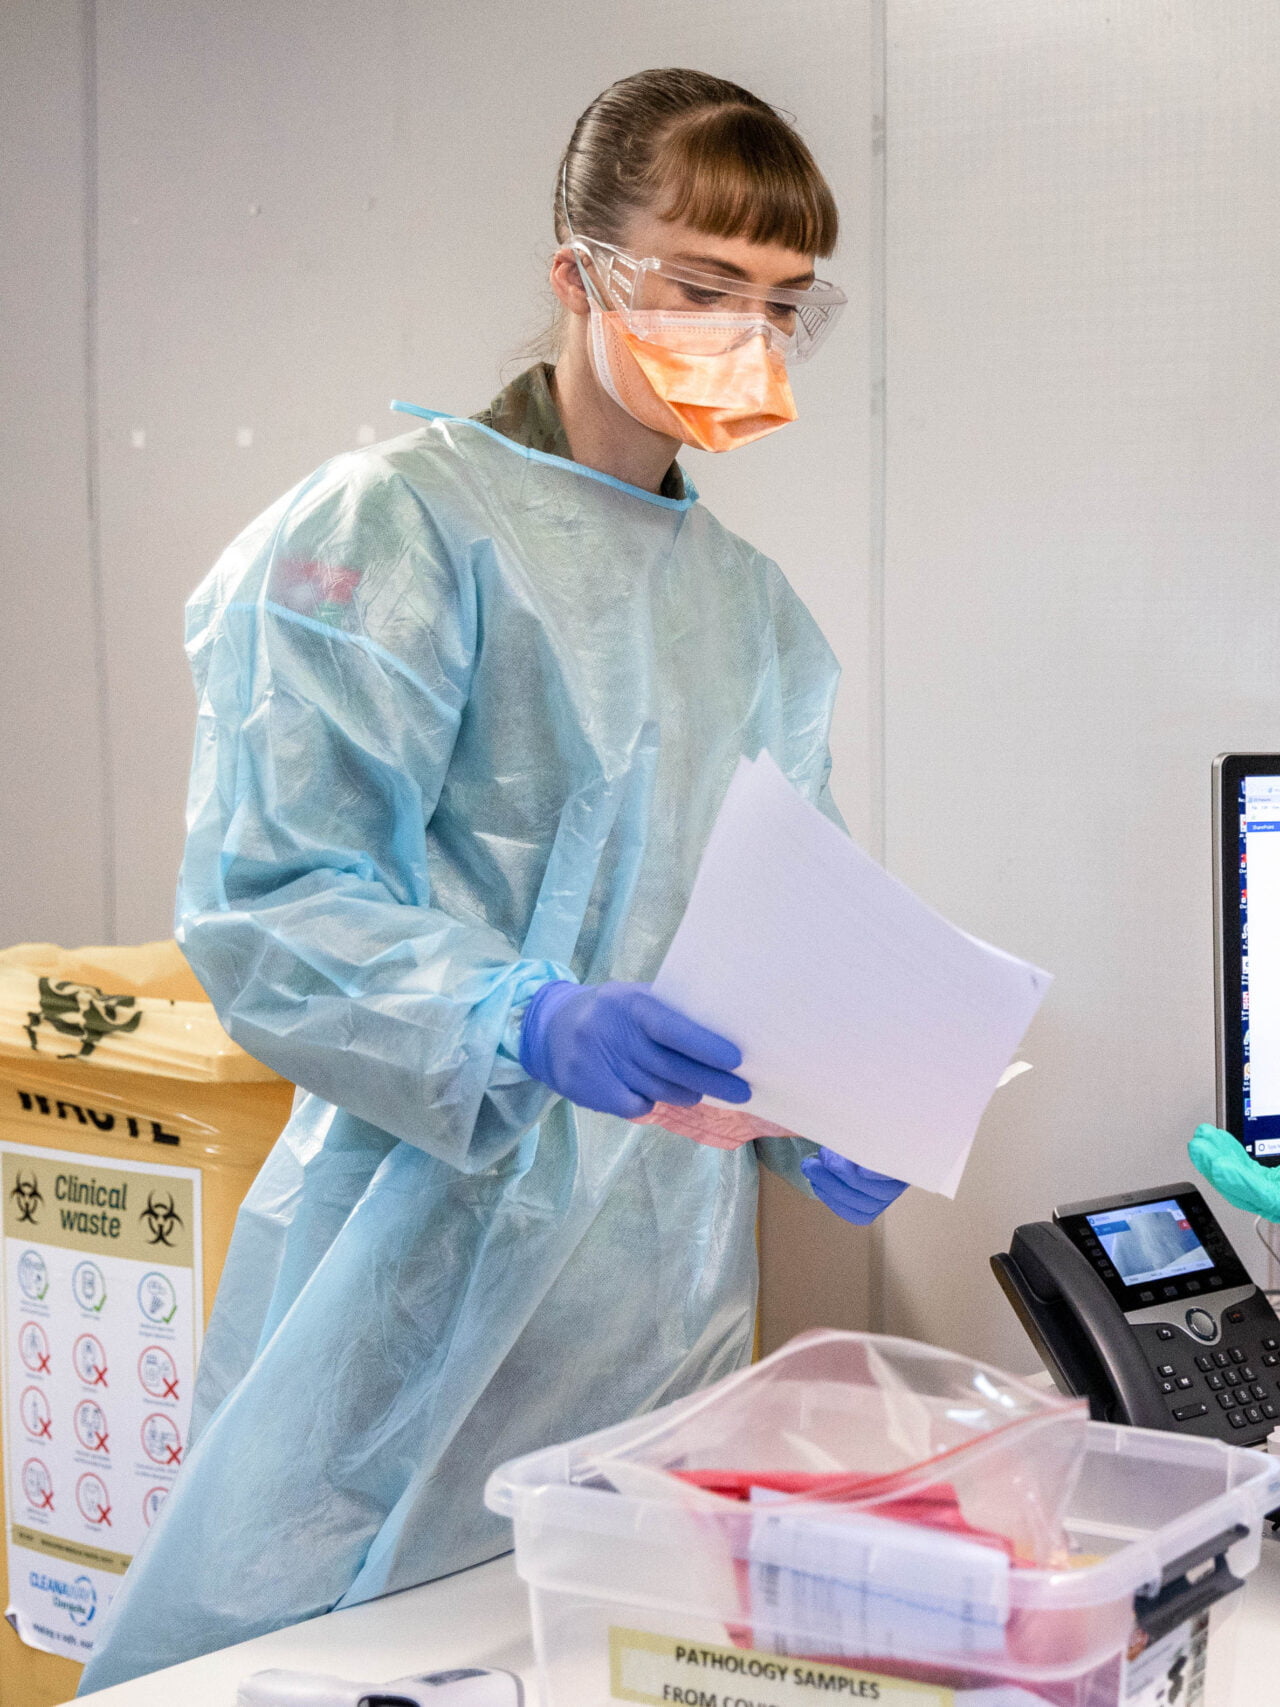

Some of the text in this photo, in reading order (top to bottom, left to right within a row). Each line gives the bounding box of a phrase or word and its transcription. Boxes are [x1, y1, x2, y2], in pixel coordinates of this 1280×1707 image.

[54, 1174, 128, 1210] Clinical
[60, 1207, 121, 1238] waste
[675, 1645, 881, 1700] PATHOLOGY SAMPLES
[662, 1683, 718, 1707] FROM
